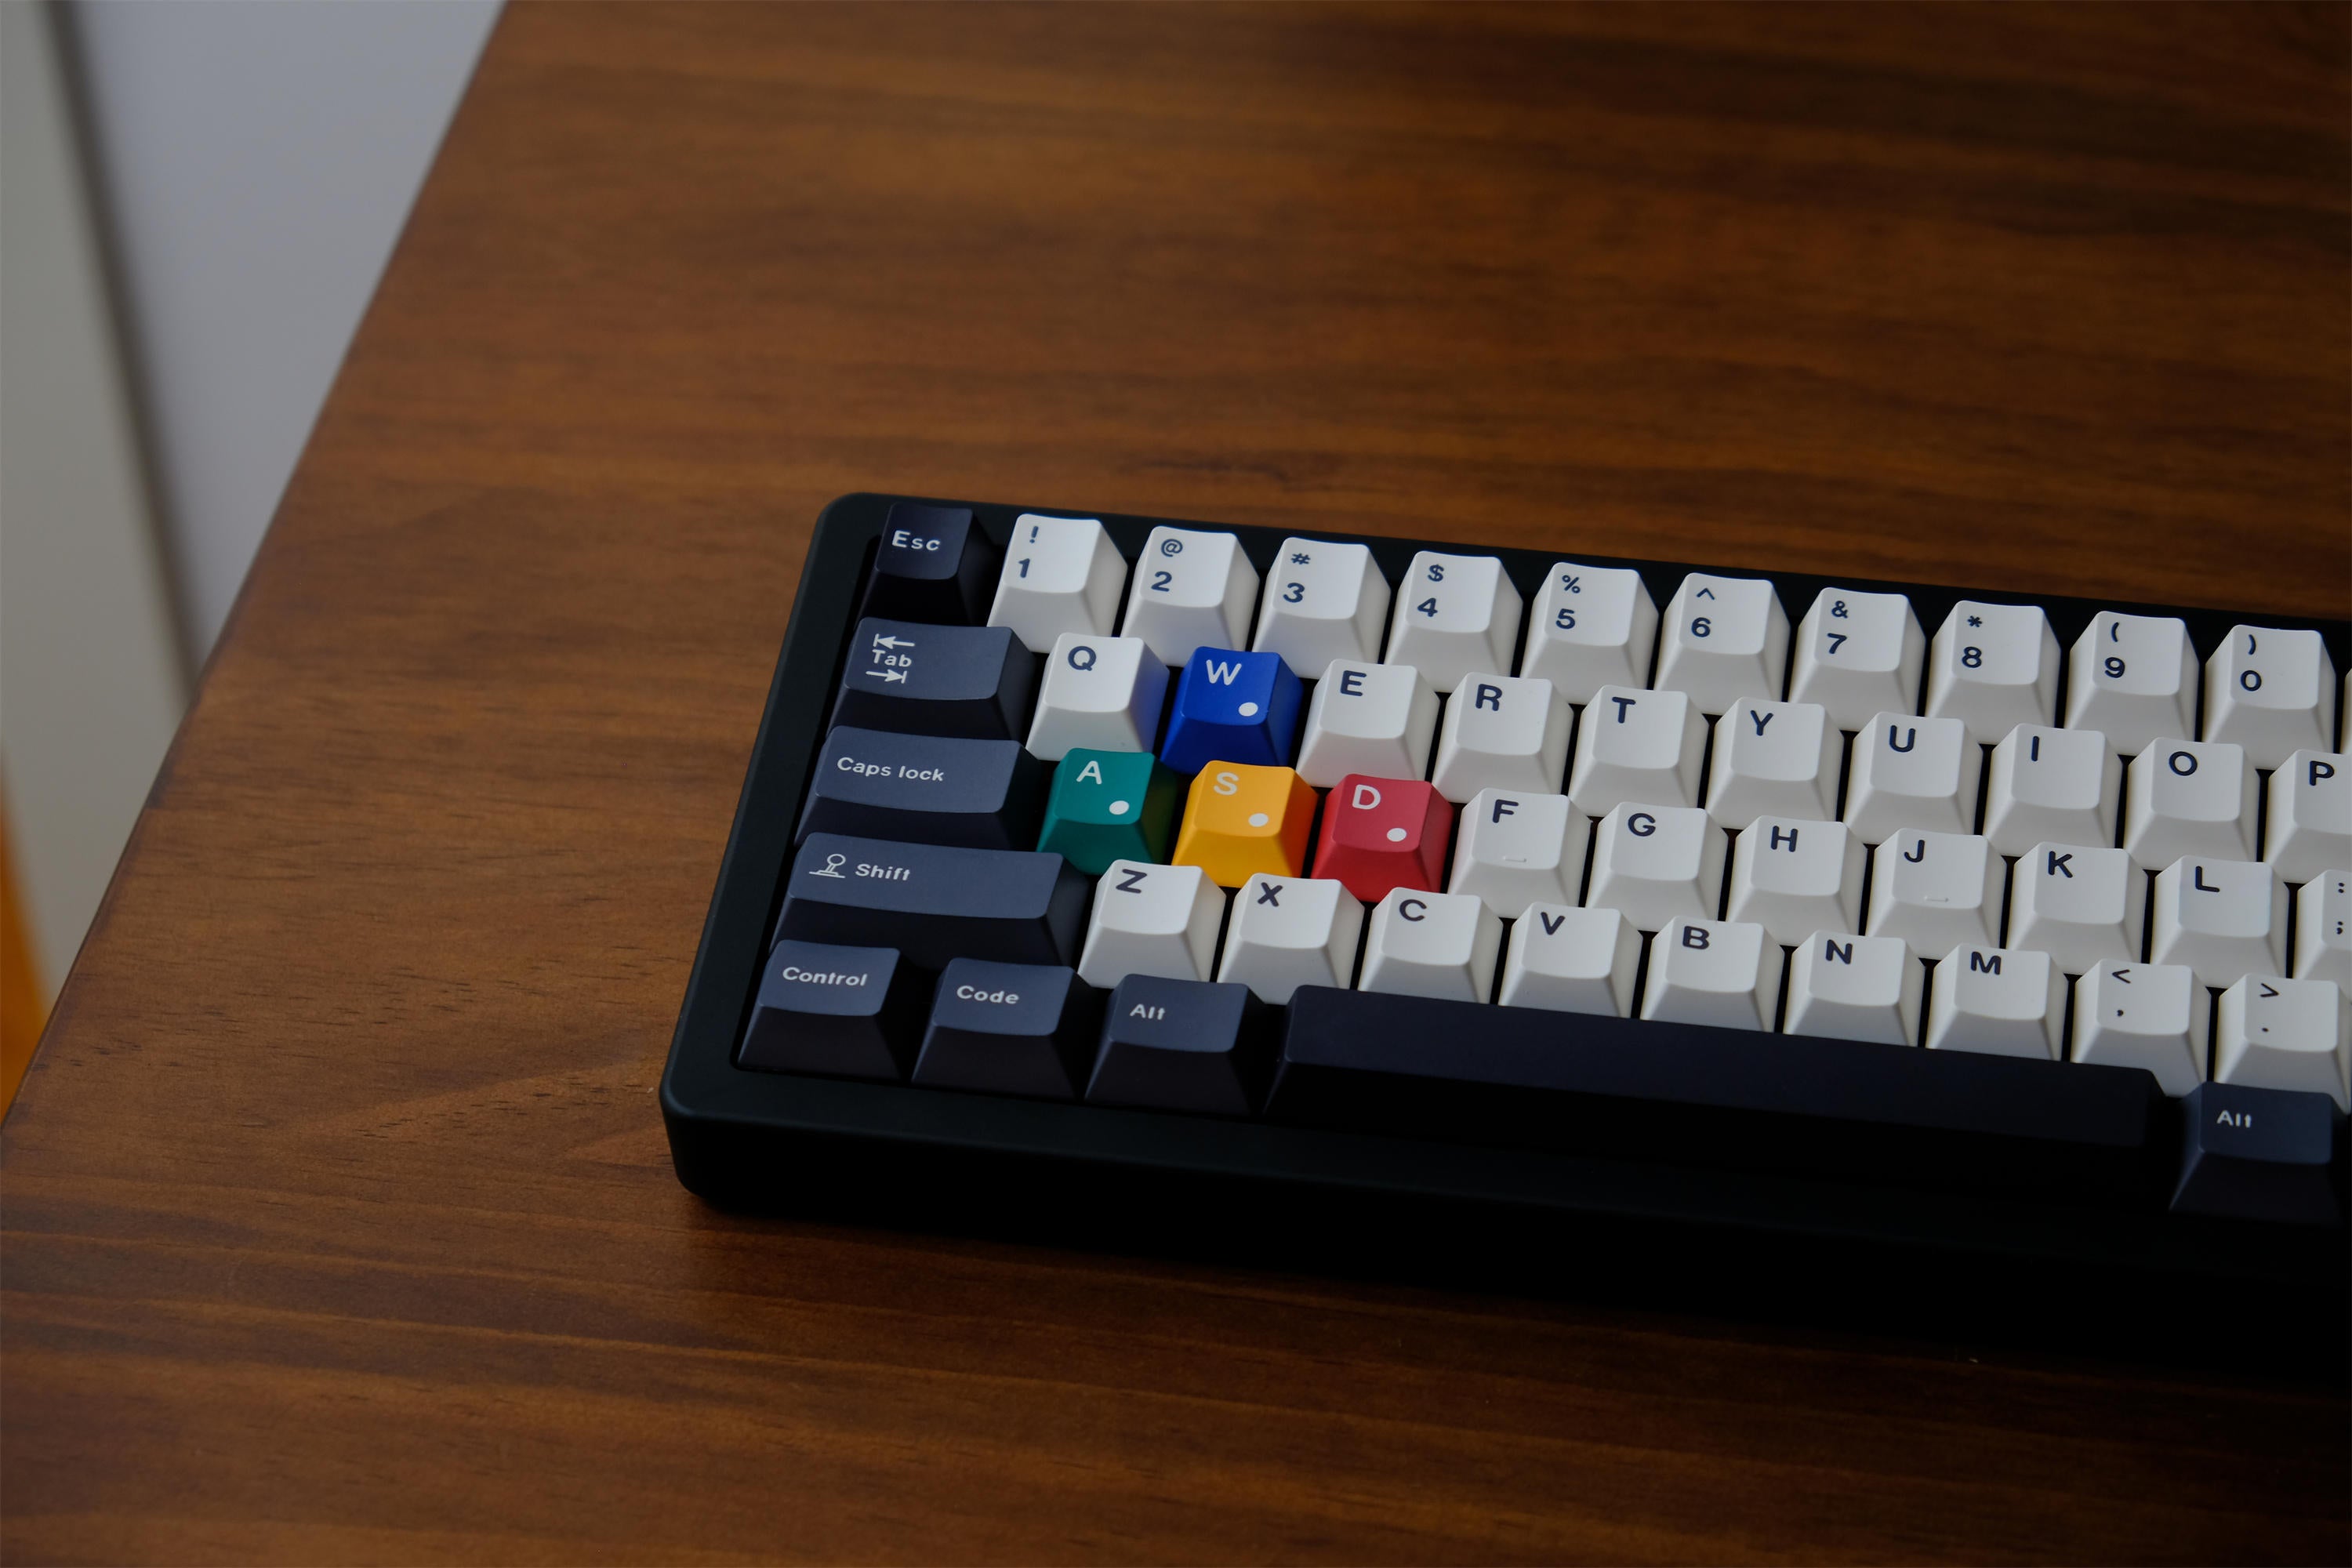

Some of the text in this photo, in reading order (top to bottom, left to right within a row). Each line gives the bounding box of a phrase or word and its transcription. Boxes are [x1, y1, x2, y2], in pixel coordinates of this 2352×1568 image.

[892, 531, 940, 550] Esc
[1029, 526, 1038, 543] !
[1161, 539, 1183, 557] @
[1019, 558, 1030, 578] 1
[1291, 554, 1310, 564] #
[1151, 572, 1172, 592] 2
[1428, 564, 1444, 582] $
[1283, 583, 1305, 603] 3
[1562, 575, 1581, 593] %
[1697, 588, 1715, 600] ^
[1417, 598, 1437, 617] 4
[1831, 601, 1847, 618] &
[1556, 608, 1575, 629] 5
[1691, 618, 1711, 637] 6
[2111, 622, 2119, 642] (
[1828, 633, 1847, 654] 7
[2249, 634, 2256, 655] )
[873, 649, 911, 666] Tab
[1068, 646, 1096, 671] Q
[1962, 647, 1981, 668] 8
[2105, 657, 2125, 678] 9
[1207, 660, 1242, 685] W
[1340, 670, 1367, 696] E
[2241, 670, 2262, 691] 0
[1475, 684, 1502, 711] R
[1612, 697, 1635, 724] T
[1751, 710, 1773, 736] Y
[1889, 725, 1915, 753] U
[2031, 736, 2039, 761] I
[837, 757, 943, 781] Caps lock
[1076, 761, 1102, 784] A
[2169, 751, 2198, 776] O
[2310, 760, 2334, 786] P
[1214, 772, 1239, 795] S
[1352, 785, 1381, 809] D
[1493, 800, 1519, 823] F
[1628, 813, 1656, 837] G
[1771, 826, 1798, 852] H
[1904, 840, 1925, 862] J
[855, 864, 909, 880] Shift
[2048, 851, 2073, 878] K
[1116, 869, 1147, 893] Z
[2195, 866, 2220, 892] L
[1258, 882, 1283, 906] X
[1399, 899, 1426, 921] C
[1541, 912, 1565, 935] V
[1682, 926, 1709, 949] B
[1826, 939, 1853, 964] N
[1971, 952, 2001, 975] M
[783, 967, 867, 985] Control
[2112, 970, 2130, 983] <
[957, 985, 1018, 1004] Code
[2260, 983, 2278, 997] >
[1131, 1004, 1164, 1020] Alt
[2217, 1111, 2251, 1127] Alt
